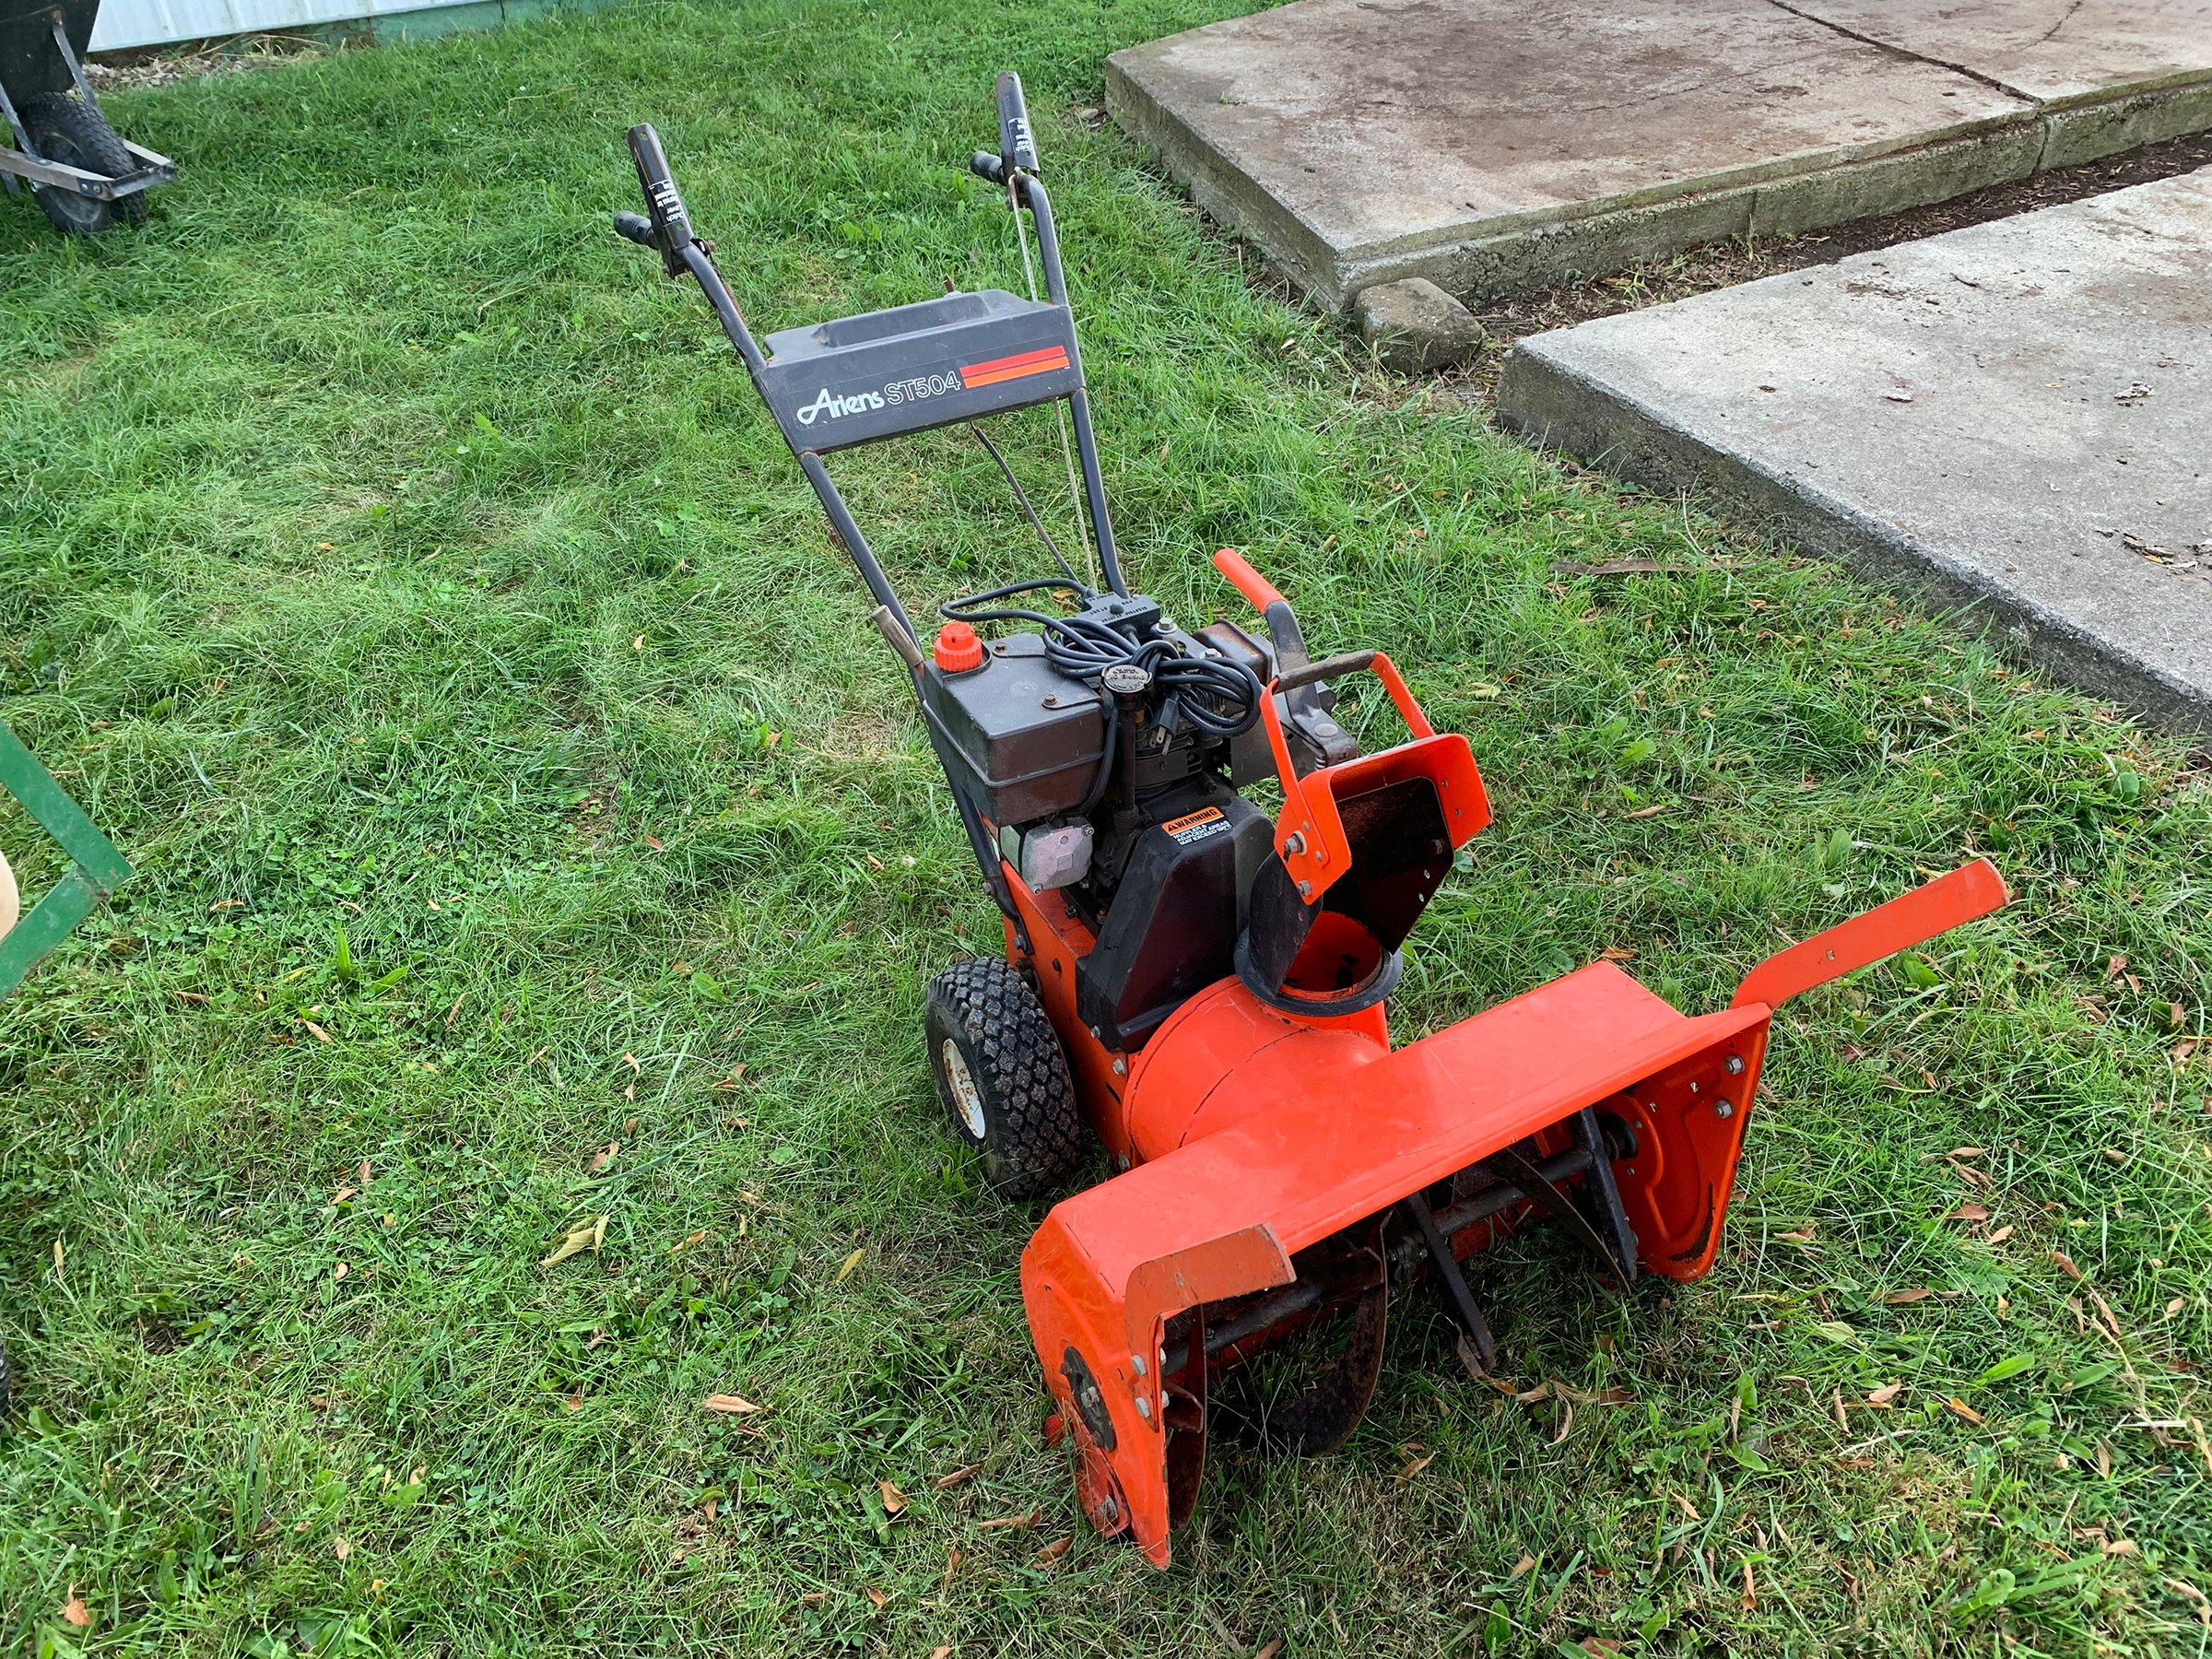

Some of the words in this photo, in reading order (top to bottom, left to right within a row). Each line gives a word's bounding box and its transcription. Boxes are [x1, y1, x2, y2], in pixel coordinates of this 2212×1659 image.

[796, 387, 886, 426] Ariens
[884, 371, 961, 406] ST504
[1175, 808, 1218, 829] WARNING
